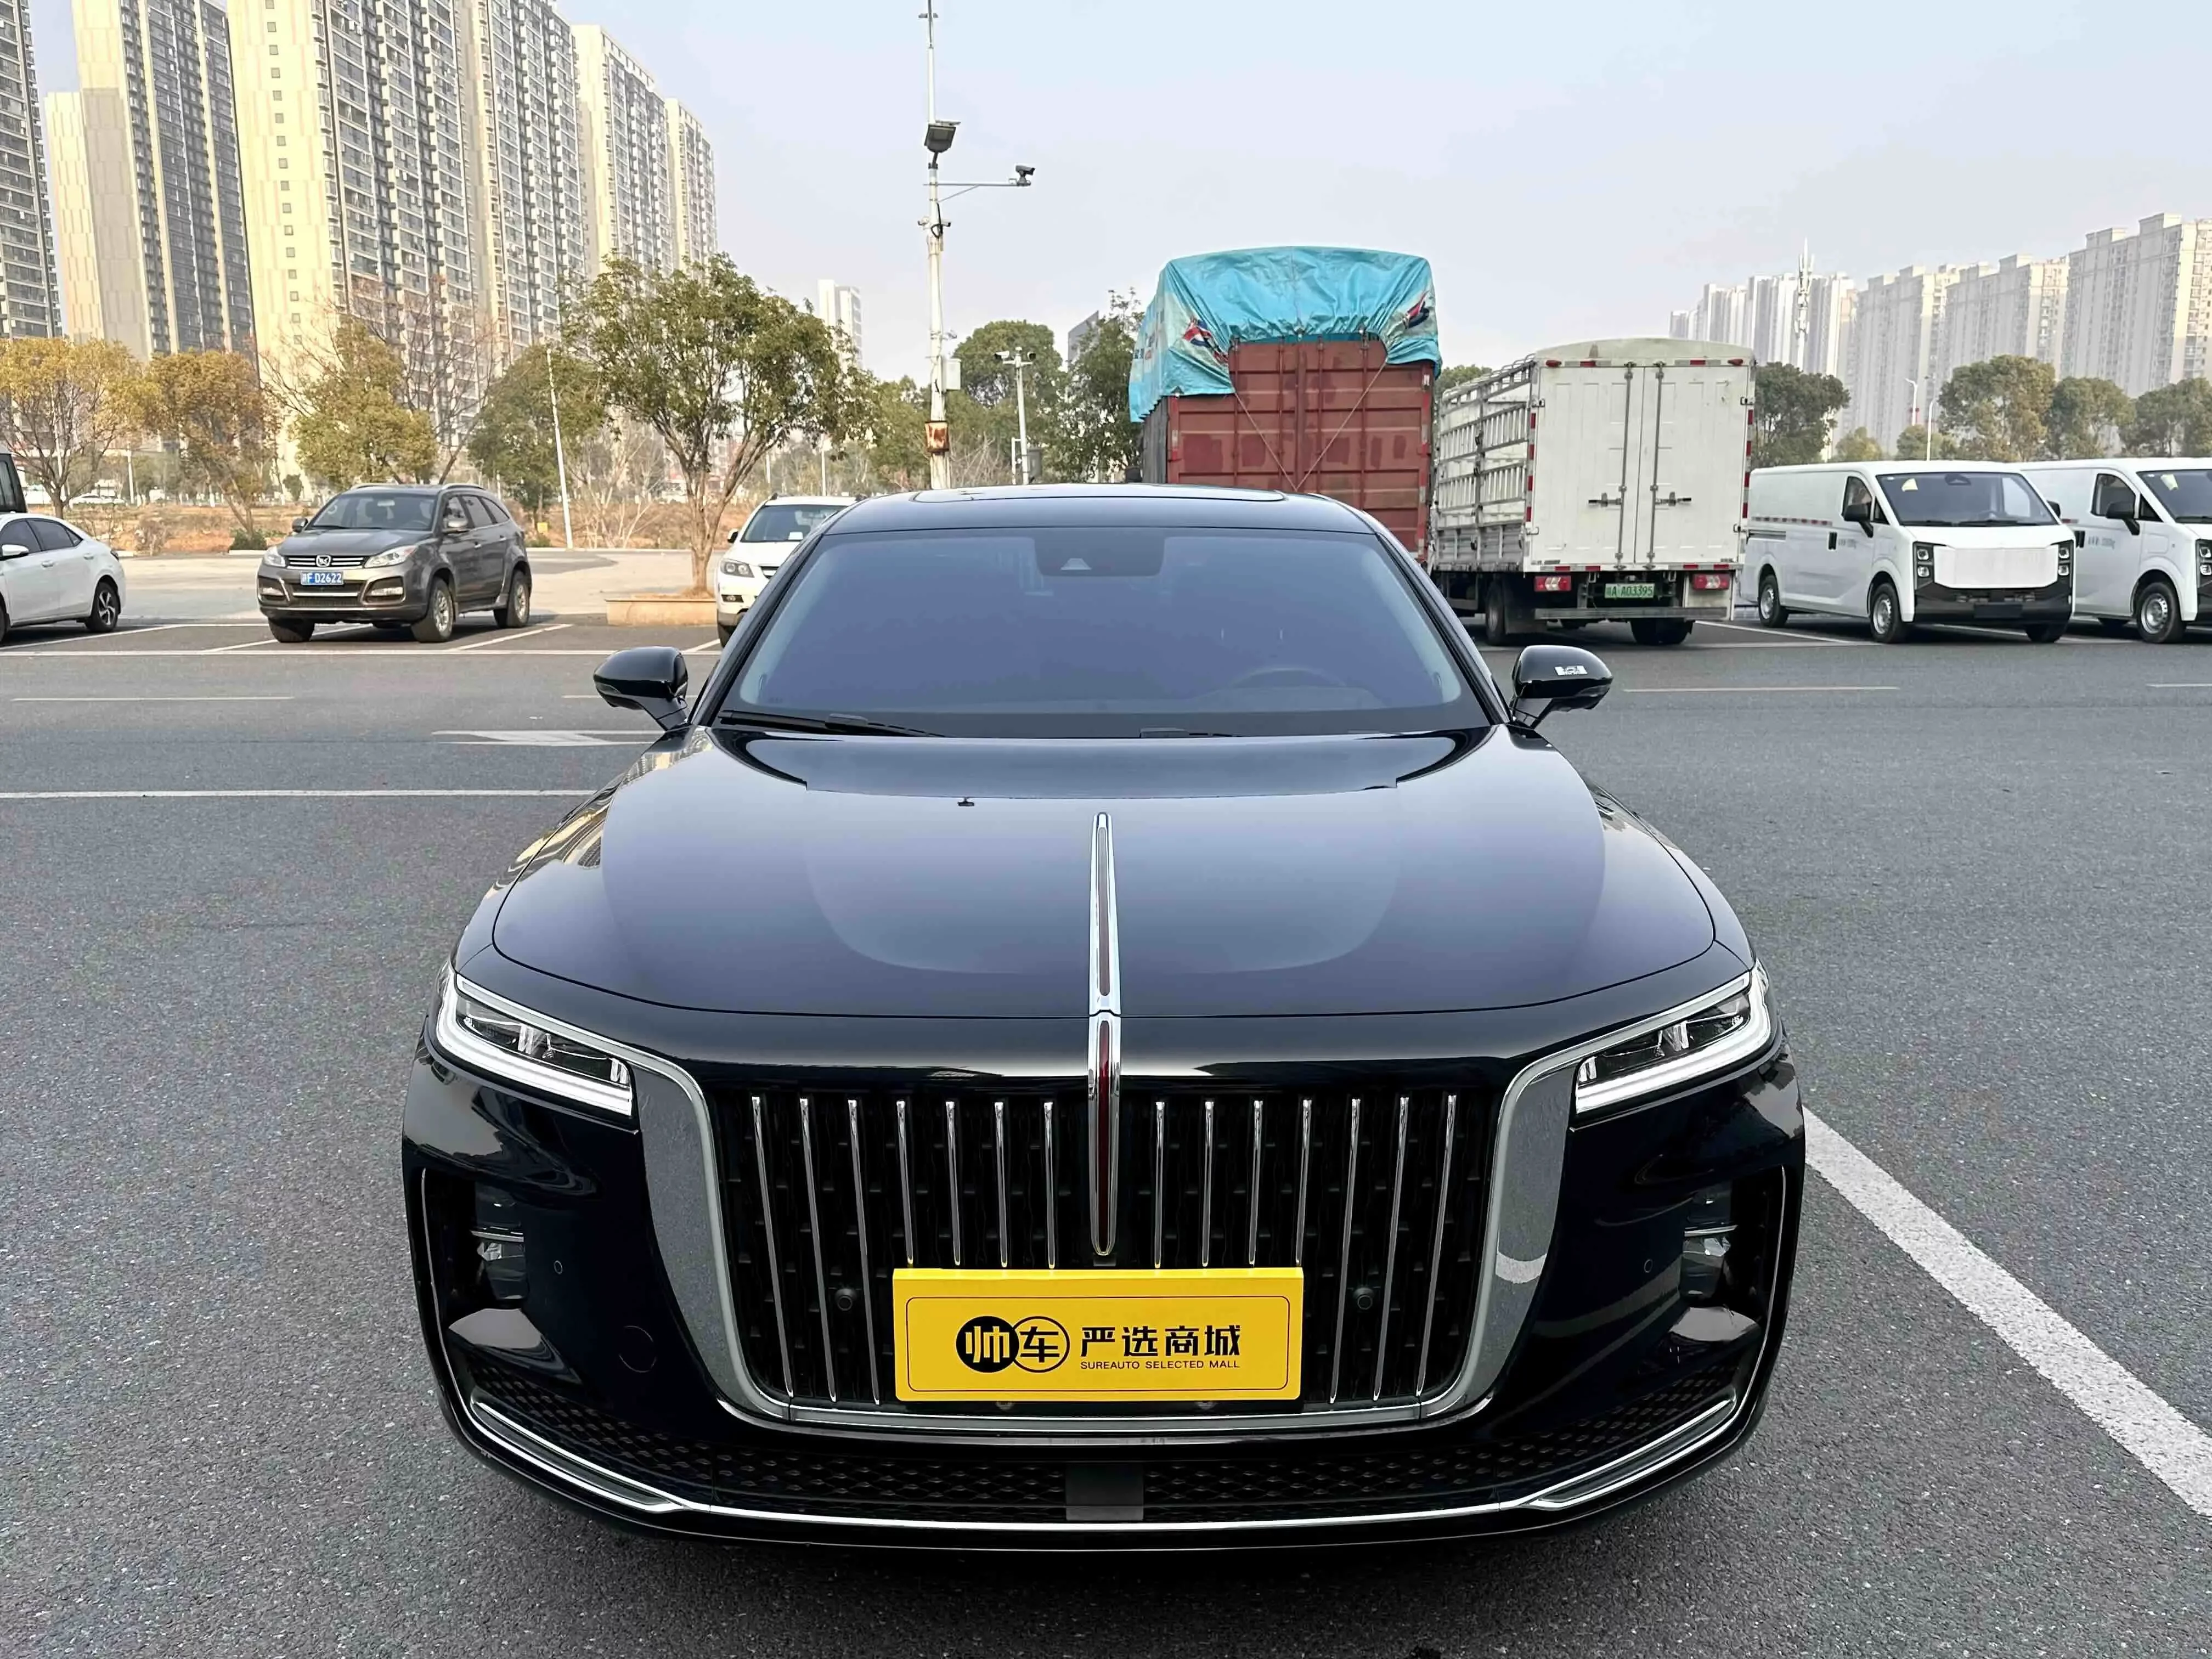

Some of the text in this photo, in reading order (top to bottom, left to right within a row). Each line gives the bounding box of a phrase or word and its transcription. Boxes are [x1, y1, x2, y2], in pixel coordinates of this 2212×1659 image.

[1081, 1325, 1240, 1357] 严选商城
[1080, 1361, 1140, 1369] SUREAUTO
[1145, 1361, 1204, 1369] SELECTED
